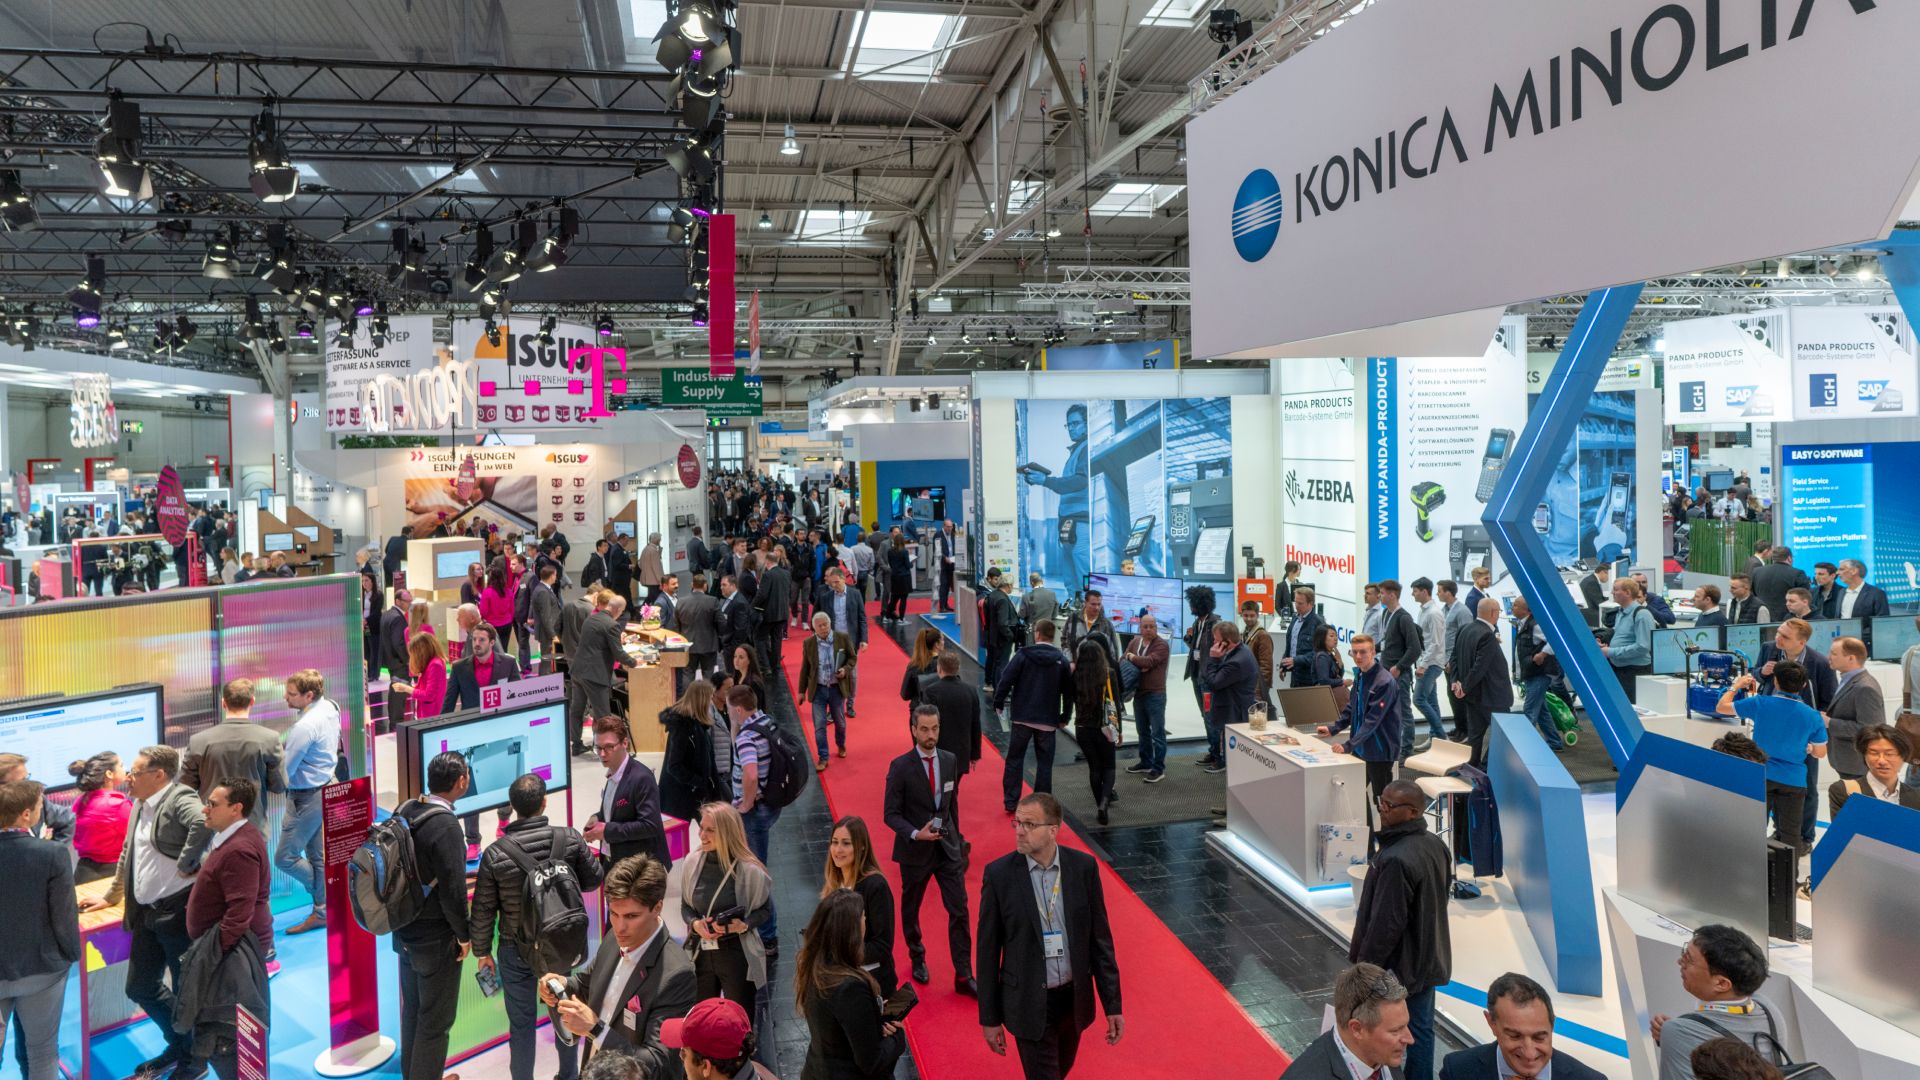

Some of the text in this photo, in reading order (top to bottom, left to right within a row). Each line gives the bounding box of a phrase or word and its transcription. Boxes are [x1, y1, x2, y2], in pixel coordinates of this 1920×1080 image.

[1295, 105, 1469, 223] KONICA
[506, 333, 586, 370] ISGUS
[1797, 342, 1876, 351] PANDA PRODUCTS
[1668, 349, 1744, 363] PANDA PRODUCTS
[359, 361, 369, 369] AS
[369, 361, 375, 369] A
[376, 360, 412, 368] SERVICE
[1143, 358, 1158, 369] EY
[682, 385, 725, 400] Supply
[1726, 389, 1751, 403] SAP
[1824, 378, 1835, 405] IGH
[1858, 383, 1883, 397] SAP
[1284, 396, 1353, 410] PANDA PRODUCTS
[1284, 410, 1353, 422] Barcode-Systeme GmbH
[1376, 356, 1389, 540] WWW.PANDA-PRODUCT
[1791, 449, 1864, 460] EASY SOFTWARE
[460, 451, 516, 461] LSUNGEN
[553, 454, 582, 464] ISGUS
[434, 463, 480, 472] EINFAH
[1307, 479, 1354, 503] ZEBRA
[159, 505, 186, 516] ANALYTICS
[1286, 544, 1355, 575] Honeywell
[517, 685, 560, 698] cosmetics
[1237, 742, 1276, 770] KONICA MINOLTA
[324, 783, 352, 795] ASSISTED
[325, 789, 349, 800] REALITY
